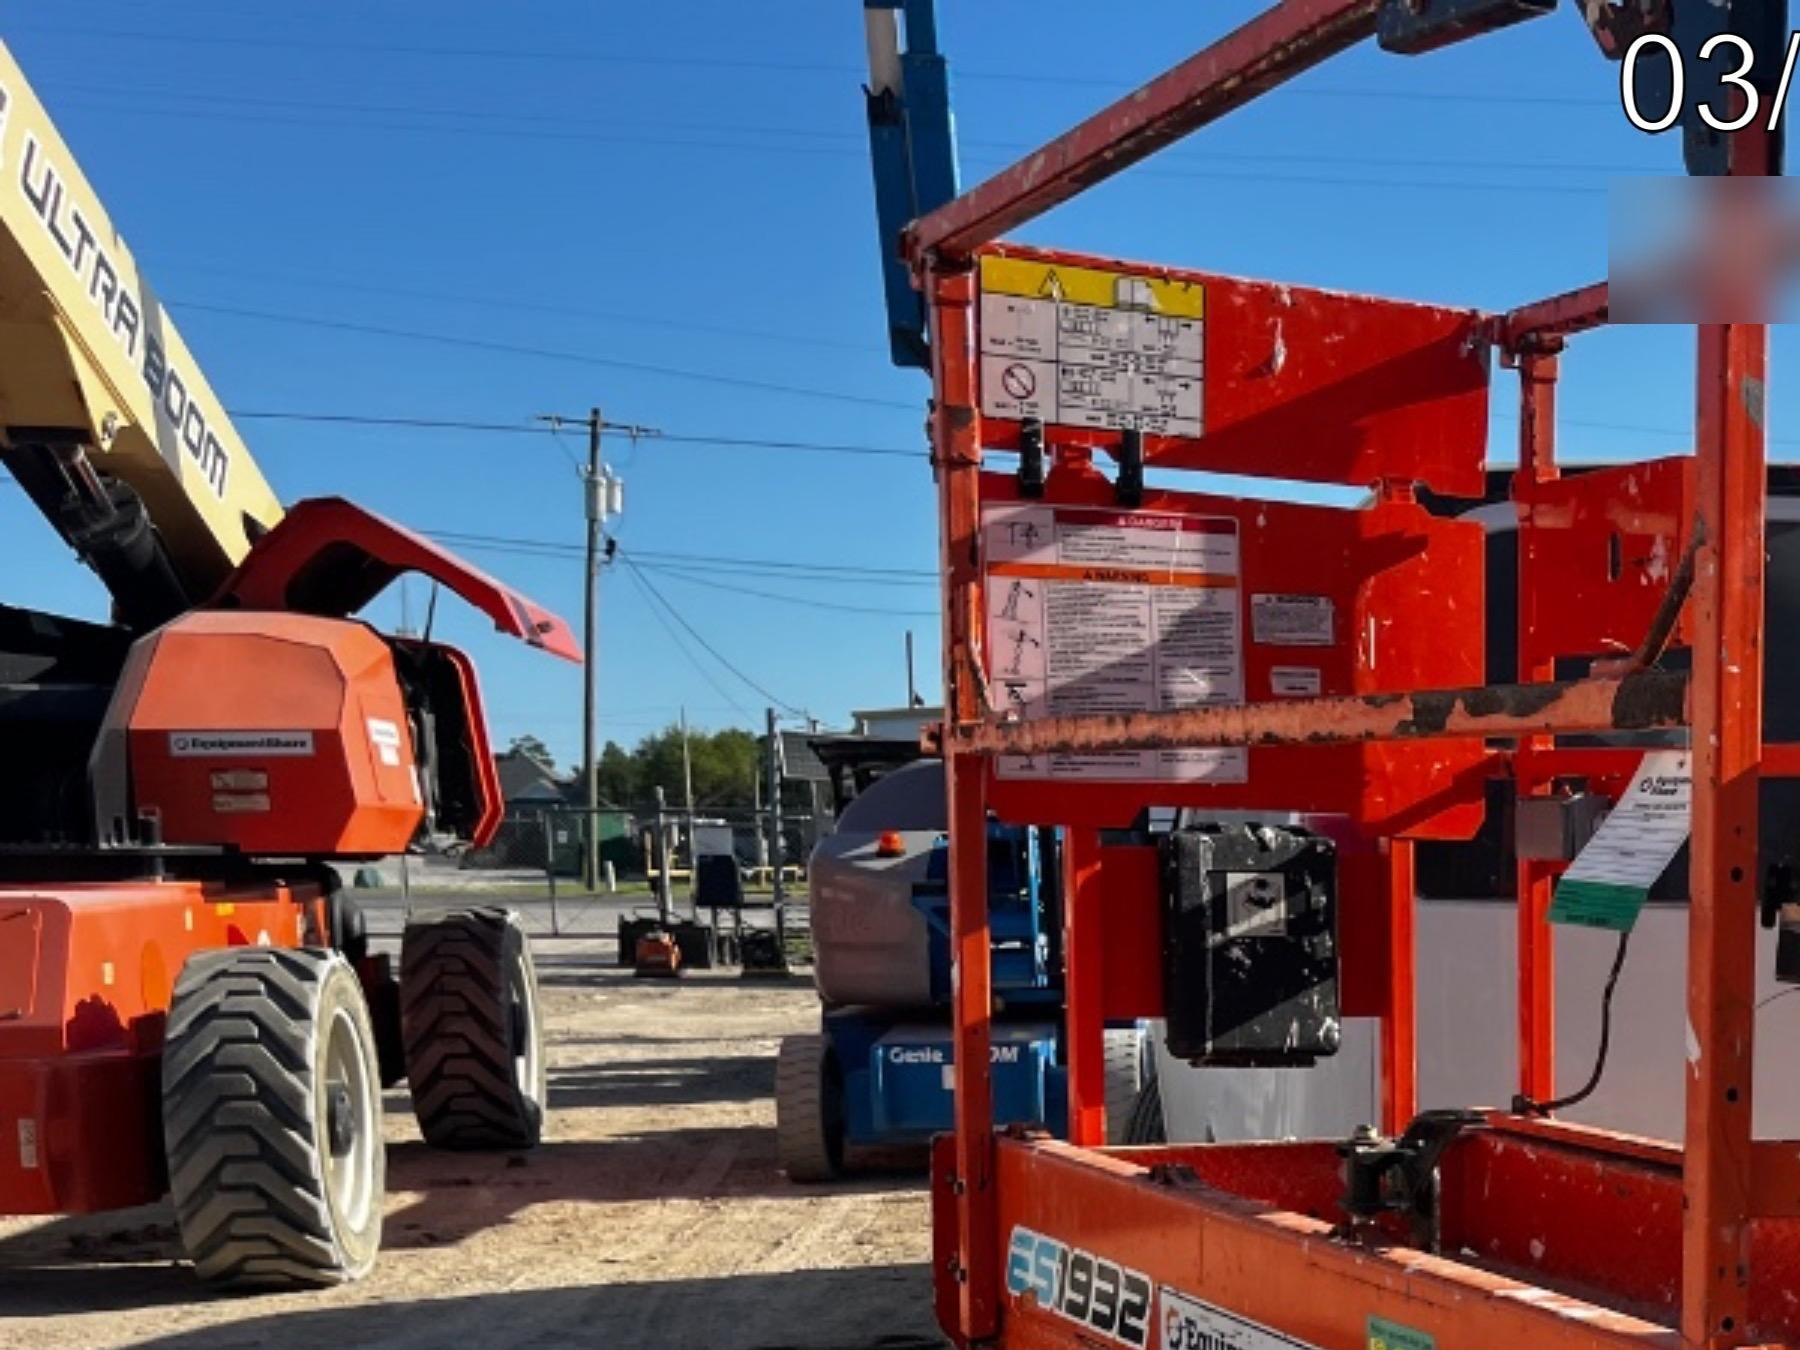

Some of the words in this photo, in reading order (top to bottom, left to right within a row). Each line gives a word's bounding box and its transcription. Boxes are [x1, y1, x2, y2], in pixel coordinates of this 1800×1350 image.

[21, 138, 140, 357] ULTRA
[143, 333, 229, 499] BOOM
[1007, 1228, 1151, 1349] ES1932
